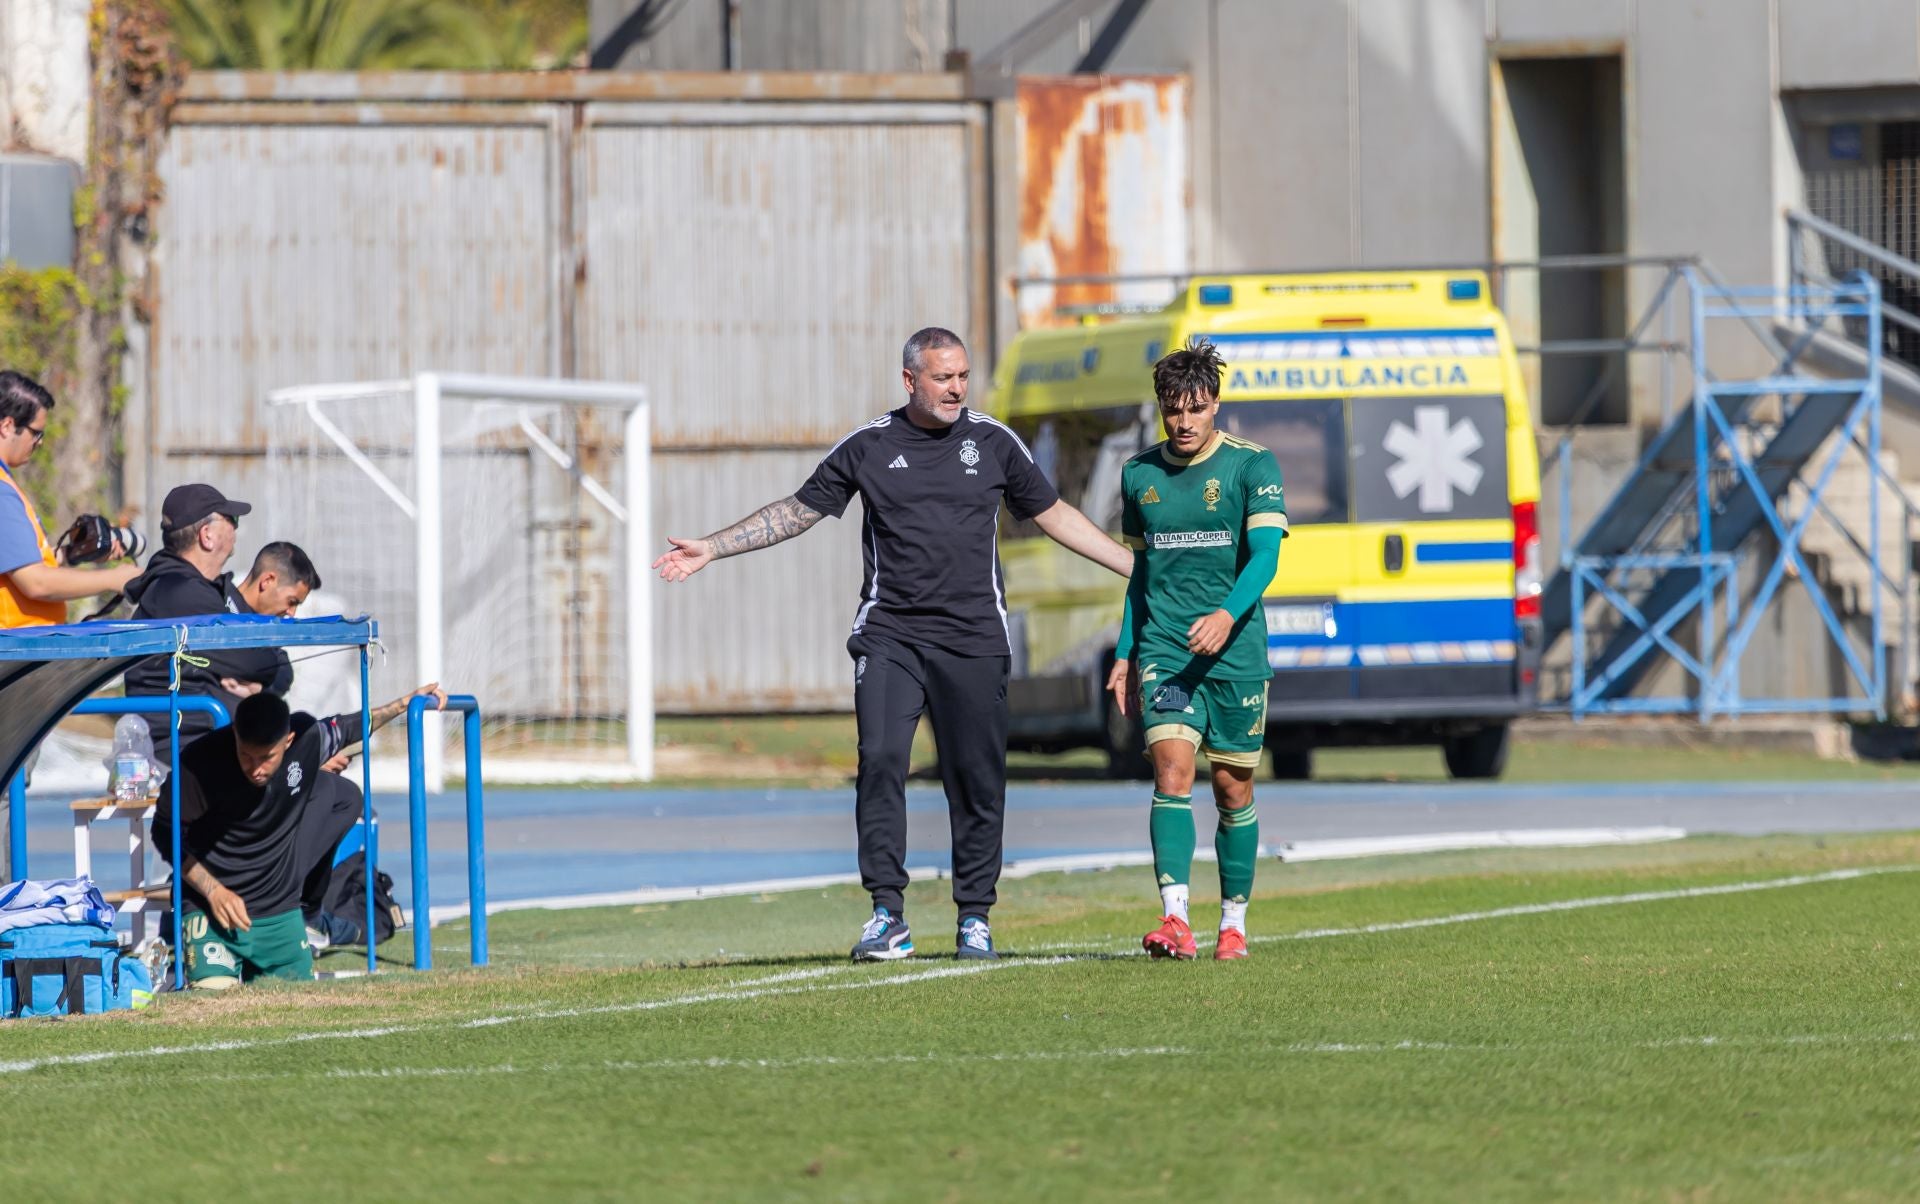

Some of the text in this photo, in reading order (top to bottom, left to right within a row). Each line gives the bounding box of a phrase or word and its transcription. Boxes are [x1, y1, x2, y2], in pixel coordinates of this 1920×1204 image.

[1229, 365, 1468, 390] AMBULANCIA
[1155, 531, 1231, 542] ATLANTIC COPPER
